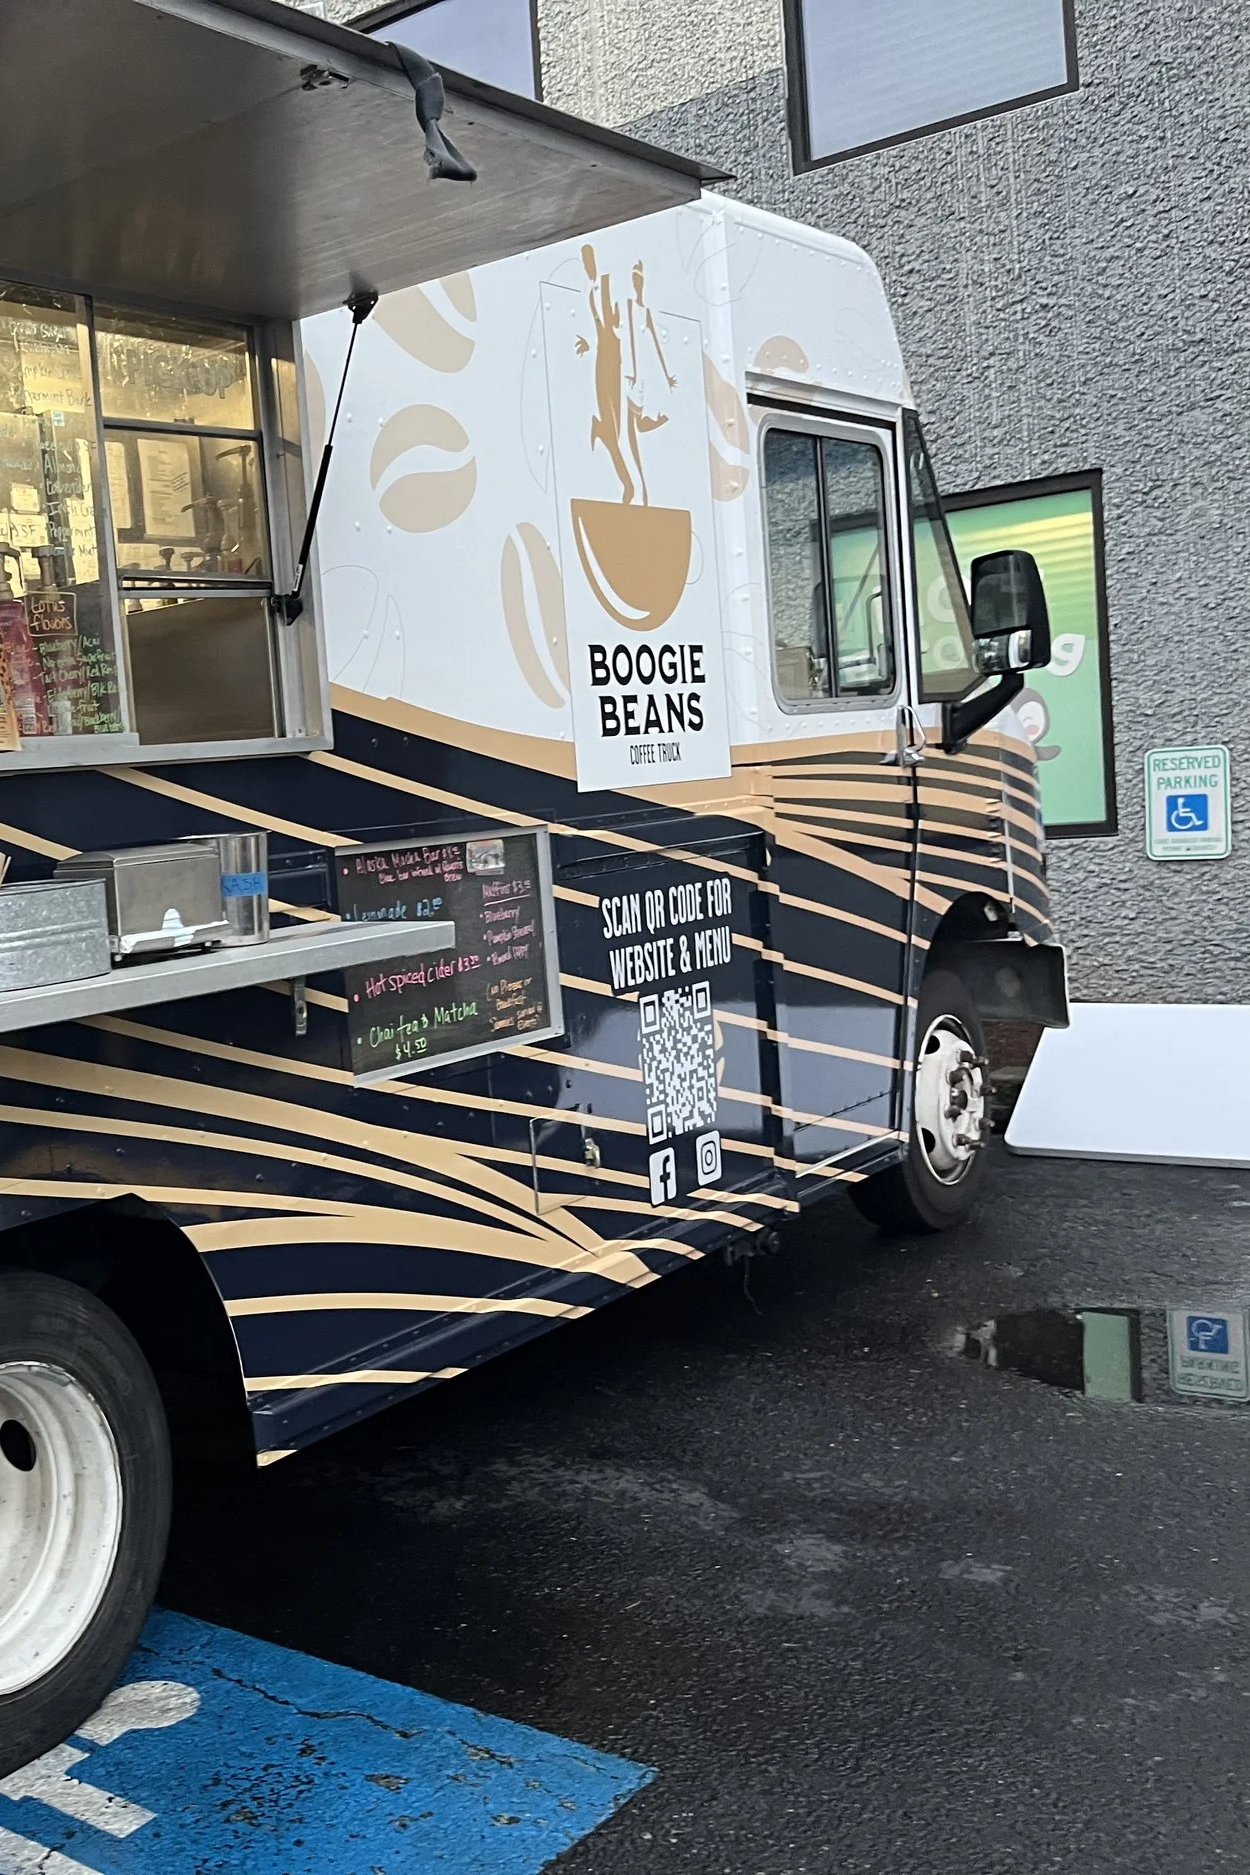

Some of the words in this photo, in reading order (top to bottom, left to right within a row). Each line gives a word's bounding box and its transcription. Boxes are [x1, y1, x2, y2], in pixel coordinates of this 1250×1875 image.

[587, 644, 706, 687] BOOGIE
[598, 692, 704, 738] BEANS
[630, 743, 656, 766] COFFEE
[657, 741, 682, 763] TRUCK
[1153, 755, 1221, 772] RESERVED
[1157, 774, 1218, 790] PARKING
[601, 894, 642, 940] SCAN
[645, 890, 666, 936] QR
[668, 883, 704, 924] CODE
[706, 877, 732, 918] FOR
[609, 937, 677, 991] WEBSITE
[679, 933, 692, 974] &
[694, 925, 732, 970] MENU
[366, 973, 387, 999] Hot
[370, 1023, 394, 1048] Chai
[435, 1002, 478, 1029] Matcha
